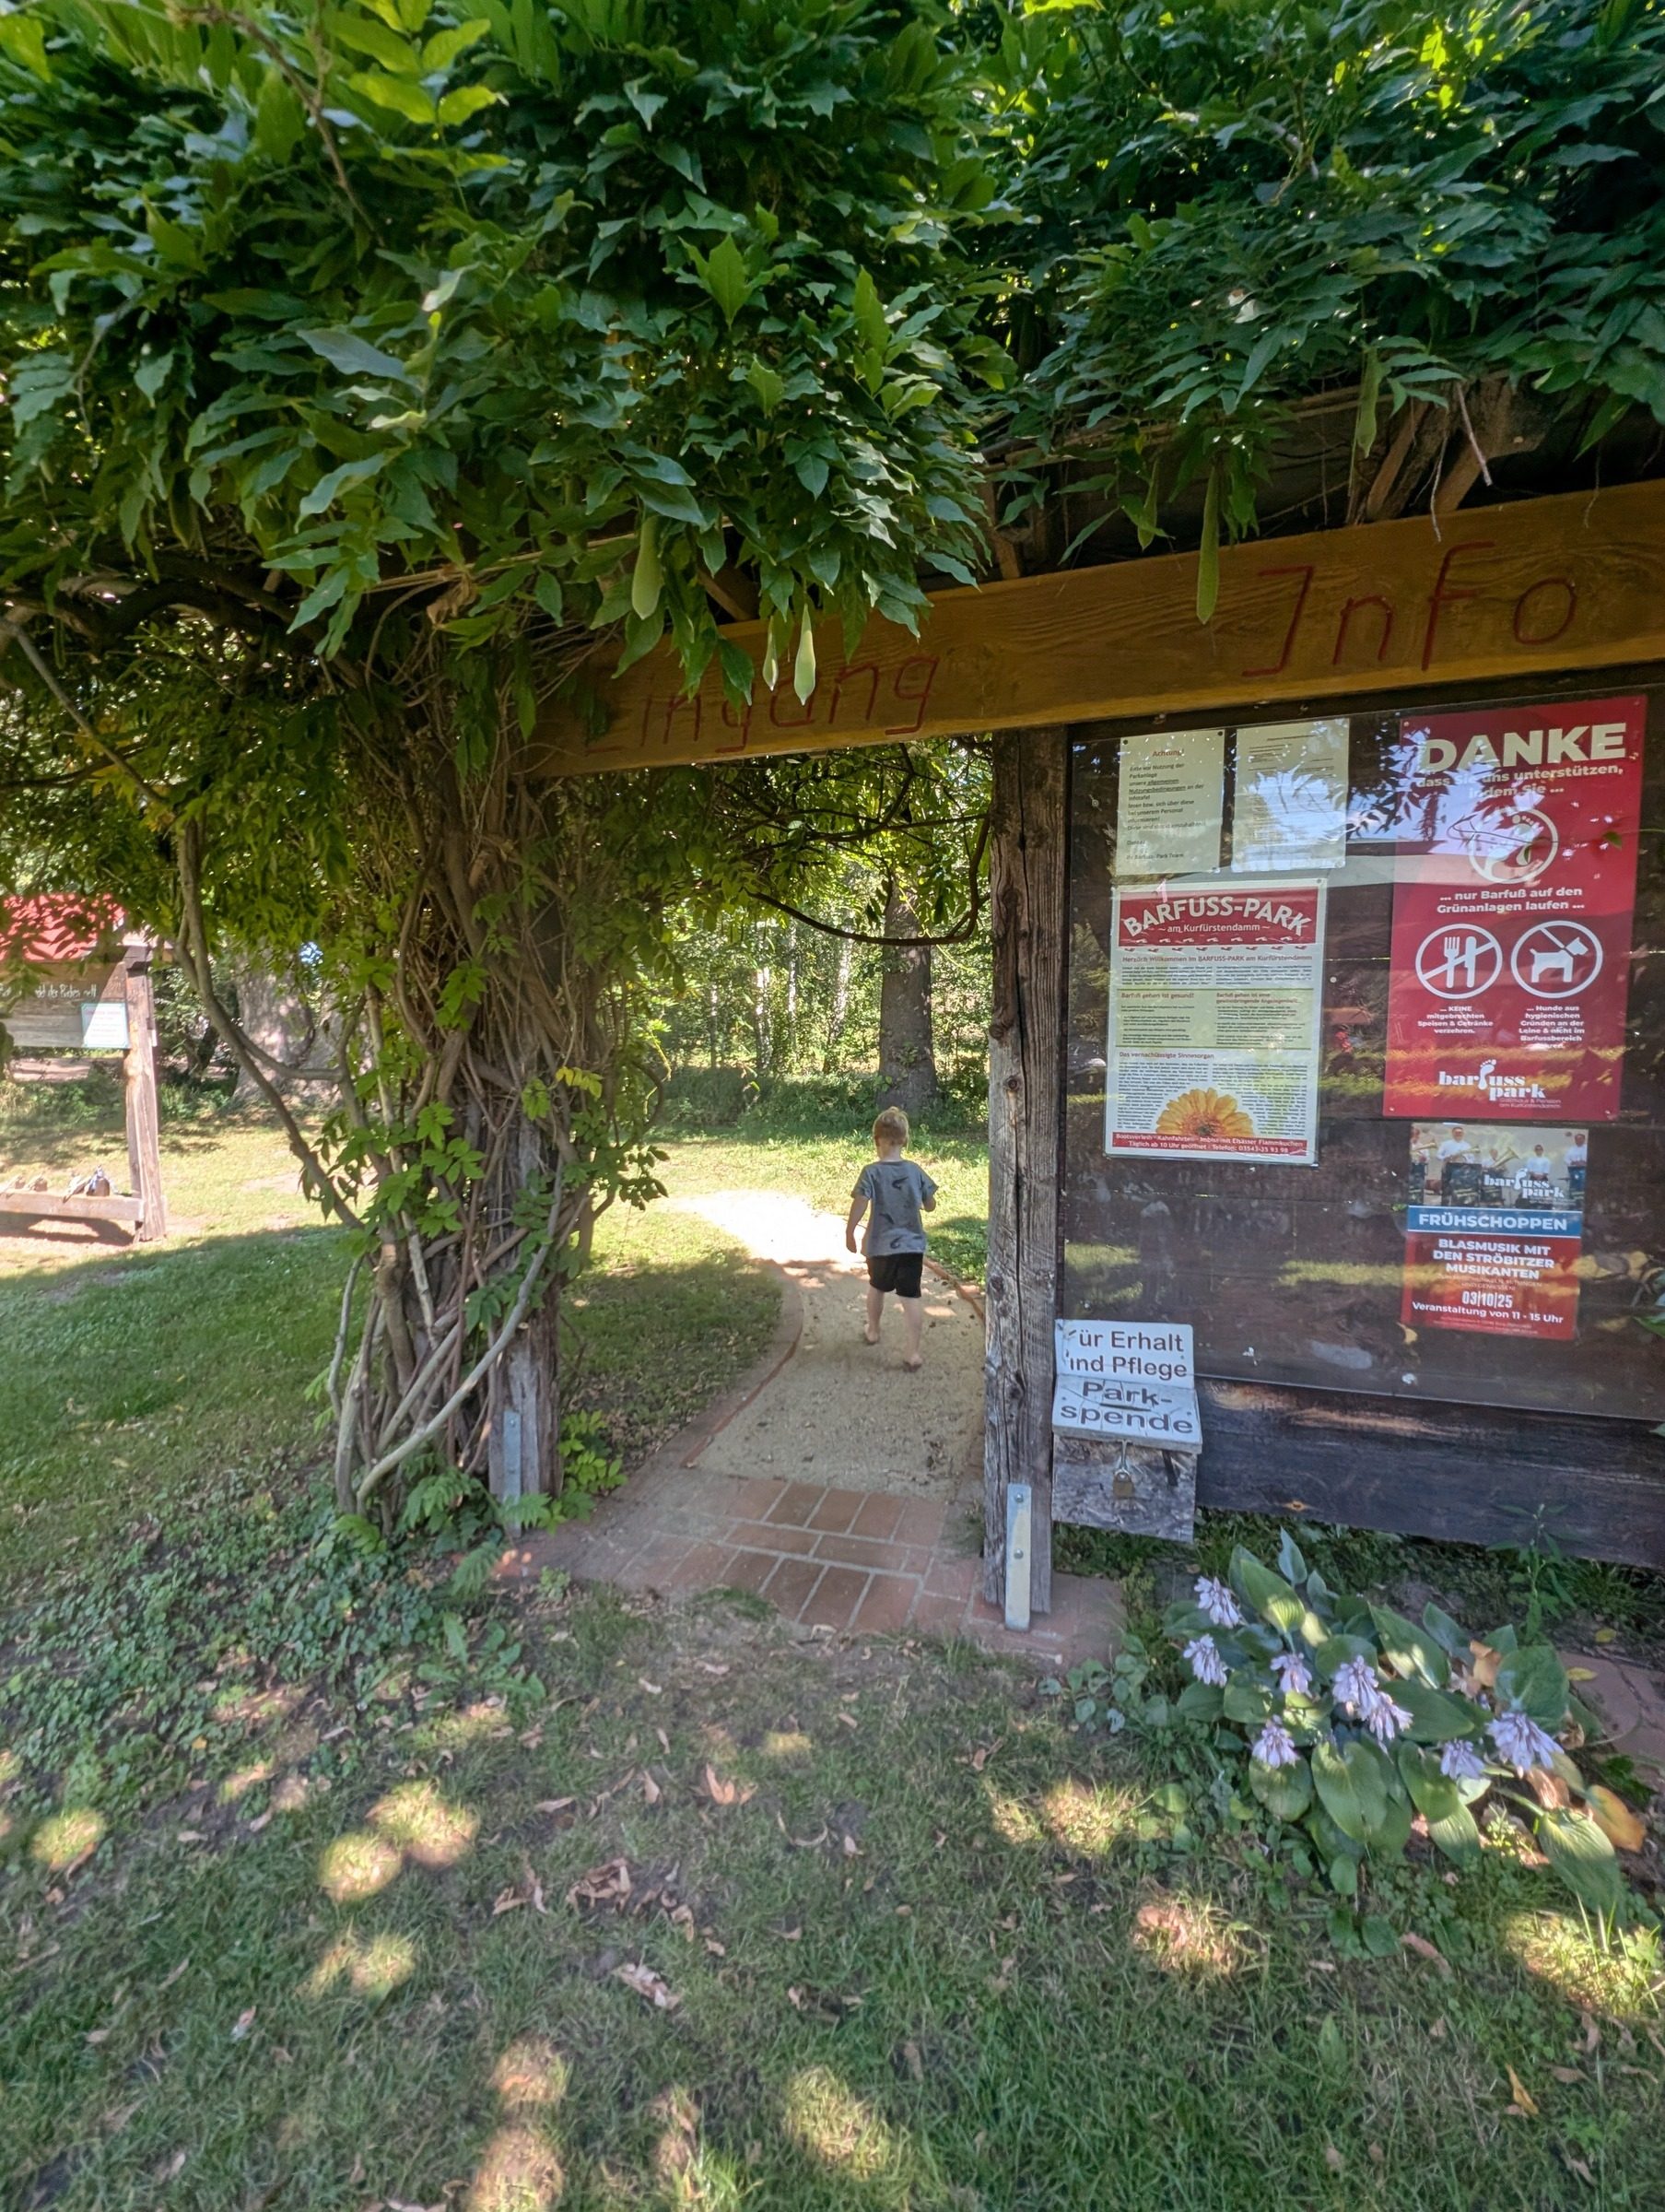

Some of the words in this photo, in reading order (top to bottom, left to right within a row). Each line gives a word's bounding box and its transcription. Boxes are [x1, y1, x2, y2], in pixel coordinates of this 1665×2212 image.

[584, 655, 941, 754] ingang
[1418, 723, 1626, 773] DANKE
[1417, 776, 1450, 787] dass
[1514, 765, 1624, 781] unterstützen,
[1455, 891, 1477, 900] nur
[1481, 888, 1526, 900] Barfuß
[1530, 887, 1553, 898] auf
[1556, 887, 1582, 897] den
[1436, 902, 1522, 913] Grünanlagen
[1526, 900, 1568, 910] laufen
[1123, 896, 1312, 937] BARFUSS-PARK
[1167, 924, 1179, 933] am
[1184, 923, 1260, 932] Kurfürstendamm
[1525, 1012, 1580, 1020] hygienischen
[1489, 1083, 1546, 1101] park
[1522, 1186, 1565, 1199] park
[1419, 1213, 1566, 1230] FRÜHSCHOPPEN
[1438, 1239, 1520, 1253] BLASMUSIK
[1524, 1244, 1551, 1256] MIT
[1433, 1250, 1462, 1262] DEN
[1466, 1251, 1554, 1269] STRÖBITZER
[1446, 1263, 1540, 1280] MUSIKANTEN
[1412, 1300, 1487, 1318] Veranstaltung
[1489, 1310, 1509, 1319] von
[1512, 1312, 1520, 1320] 11
[1530, 1312, 1541, 1322] 15
[1543, 1313, 1564, 1324] Uhr
[1111, 1330, 1184, 1352] Erhalt
[1112, 1356, 1187, 1381] Pflege
[1083, 1381, 1173, 1406] Park-
[1061, 1404, 1193, 1434] spende
